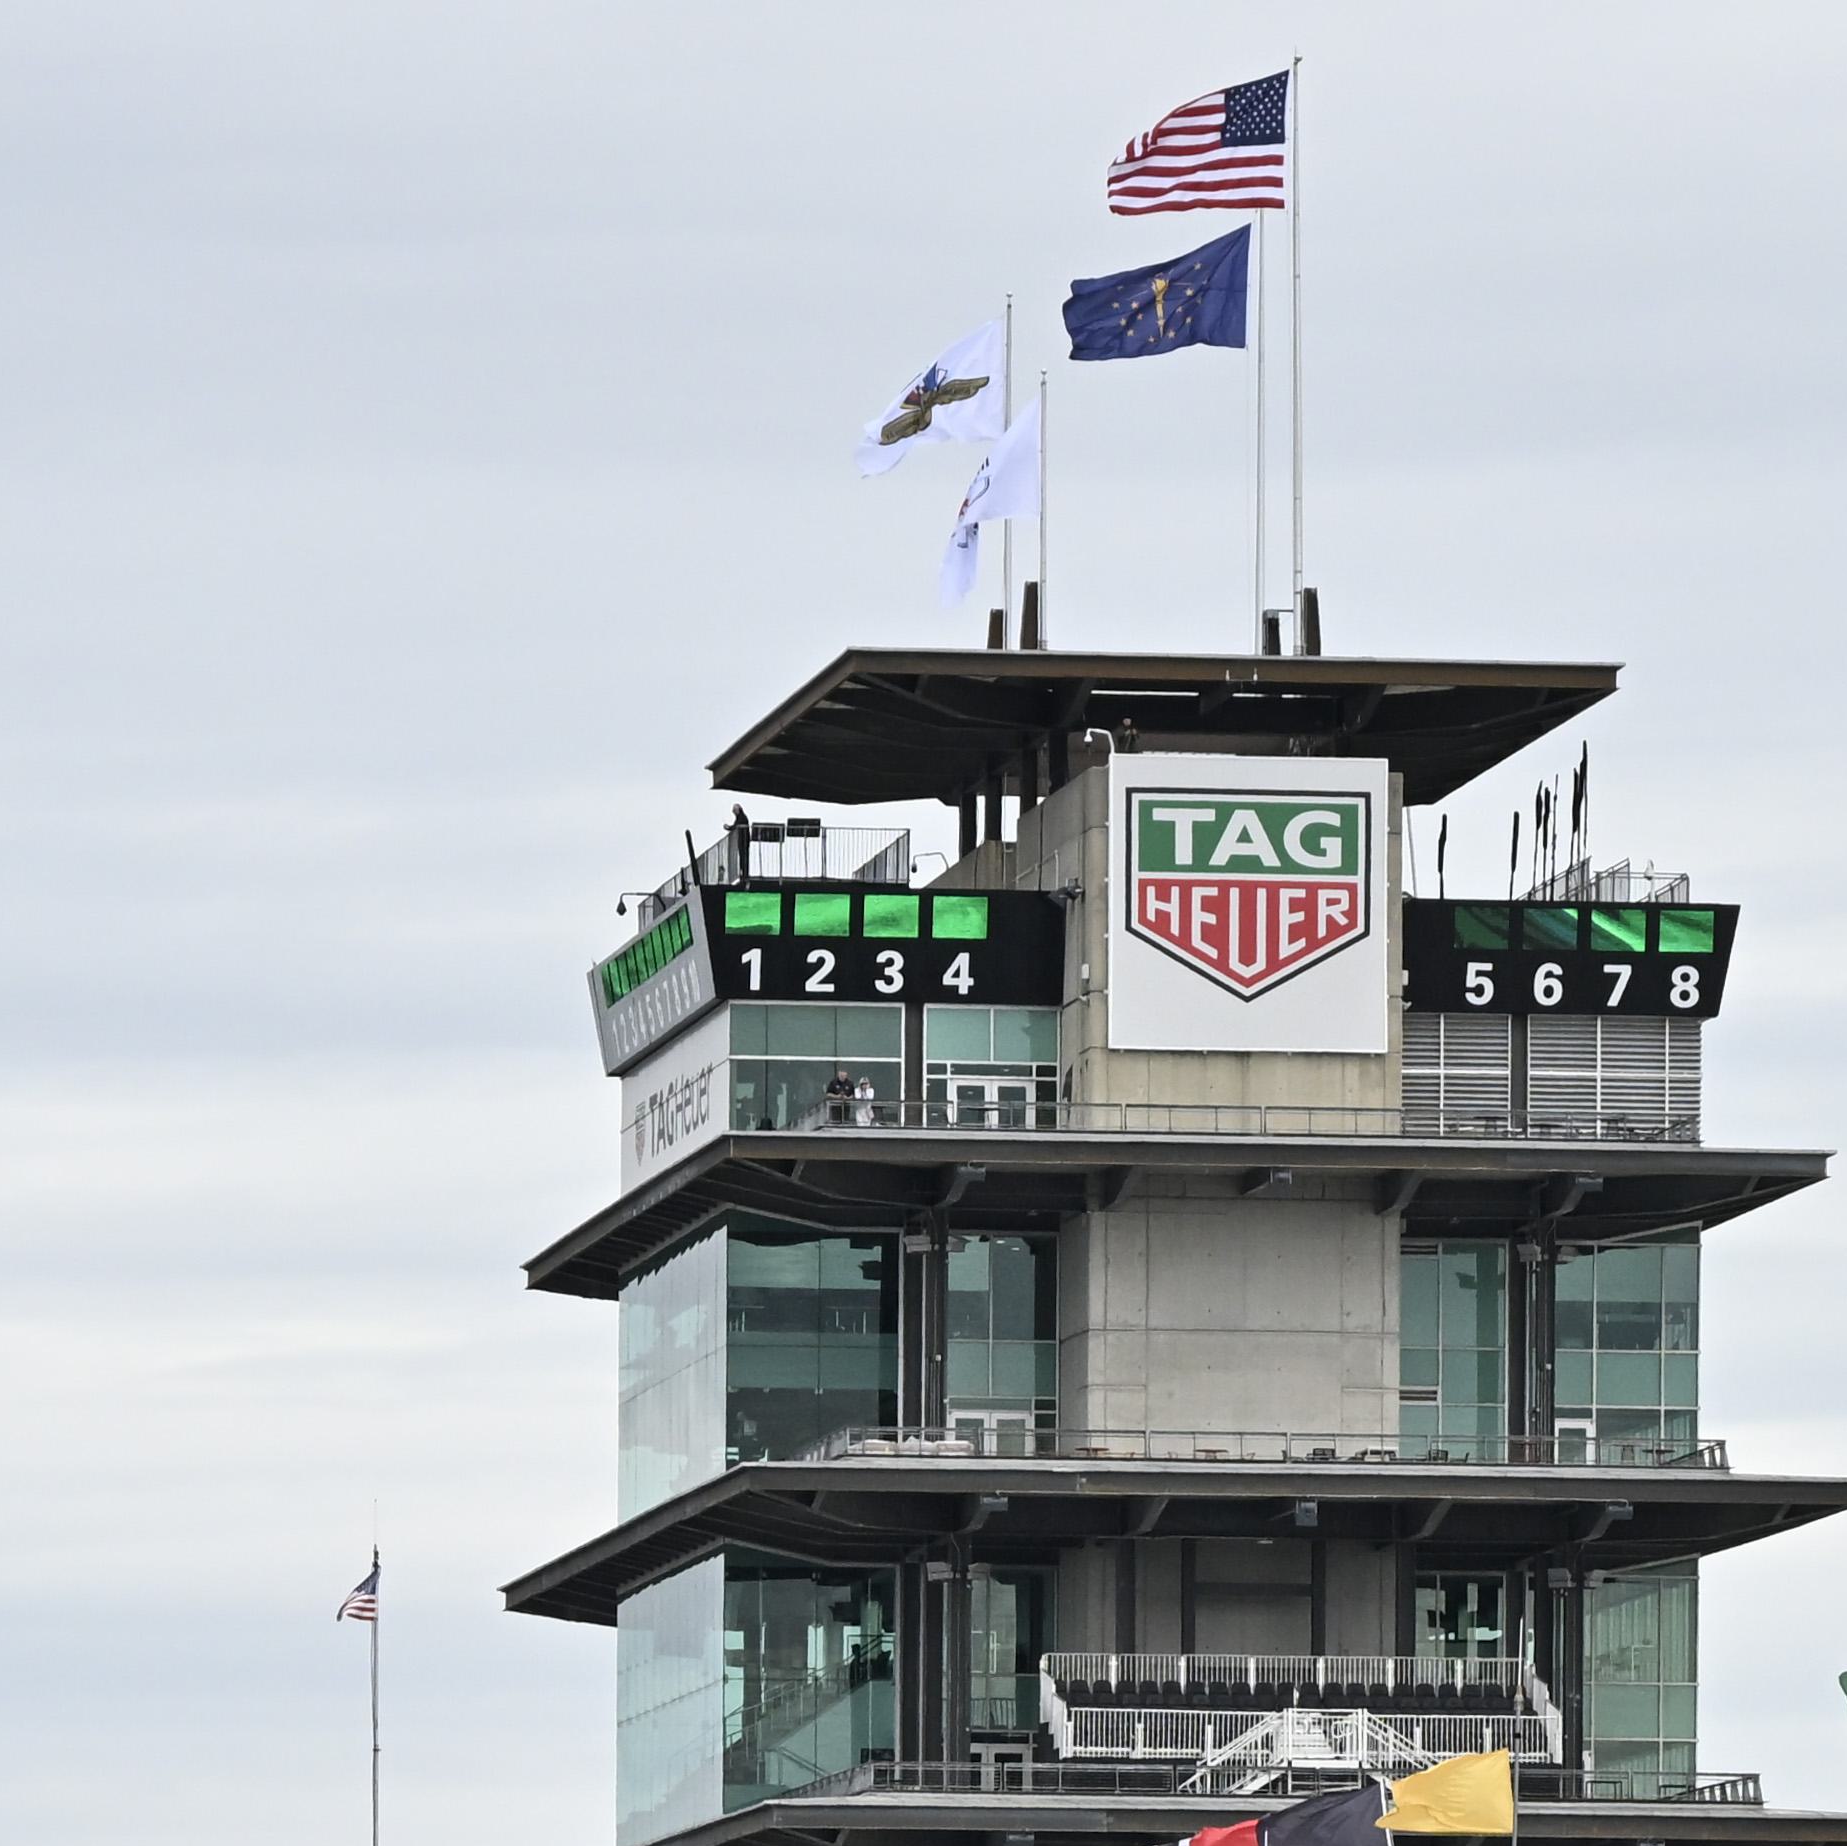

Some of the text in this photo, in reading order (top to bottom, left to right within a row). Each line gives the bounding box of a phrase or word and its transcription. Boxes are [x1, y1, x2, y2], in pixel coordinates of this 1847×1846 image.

[1152, 809, 1343, 868] TAG
[1146, 886, 1349, 978] HEUER
[740, 948, 975, 995] 1 2 3 4
[1465, 962, 1700, 1008] 5 6 7 8
